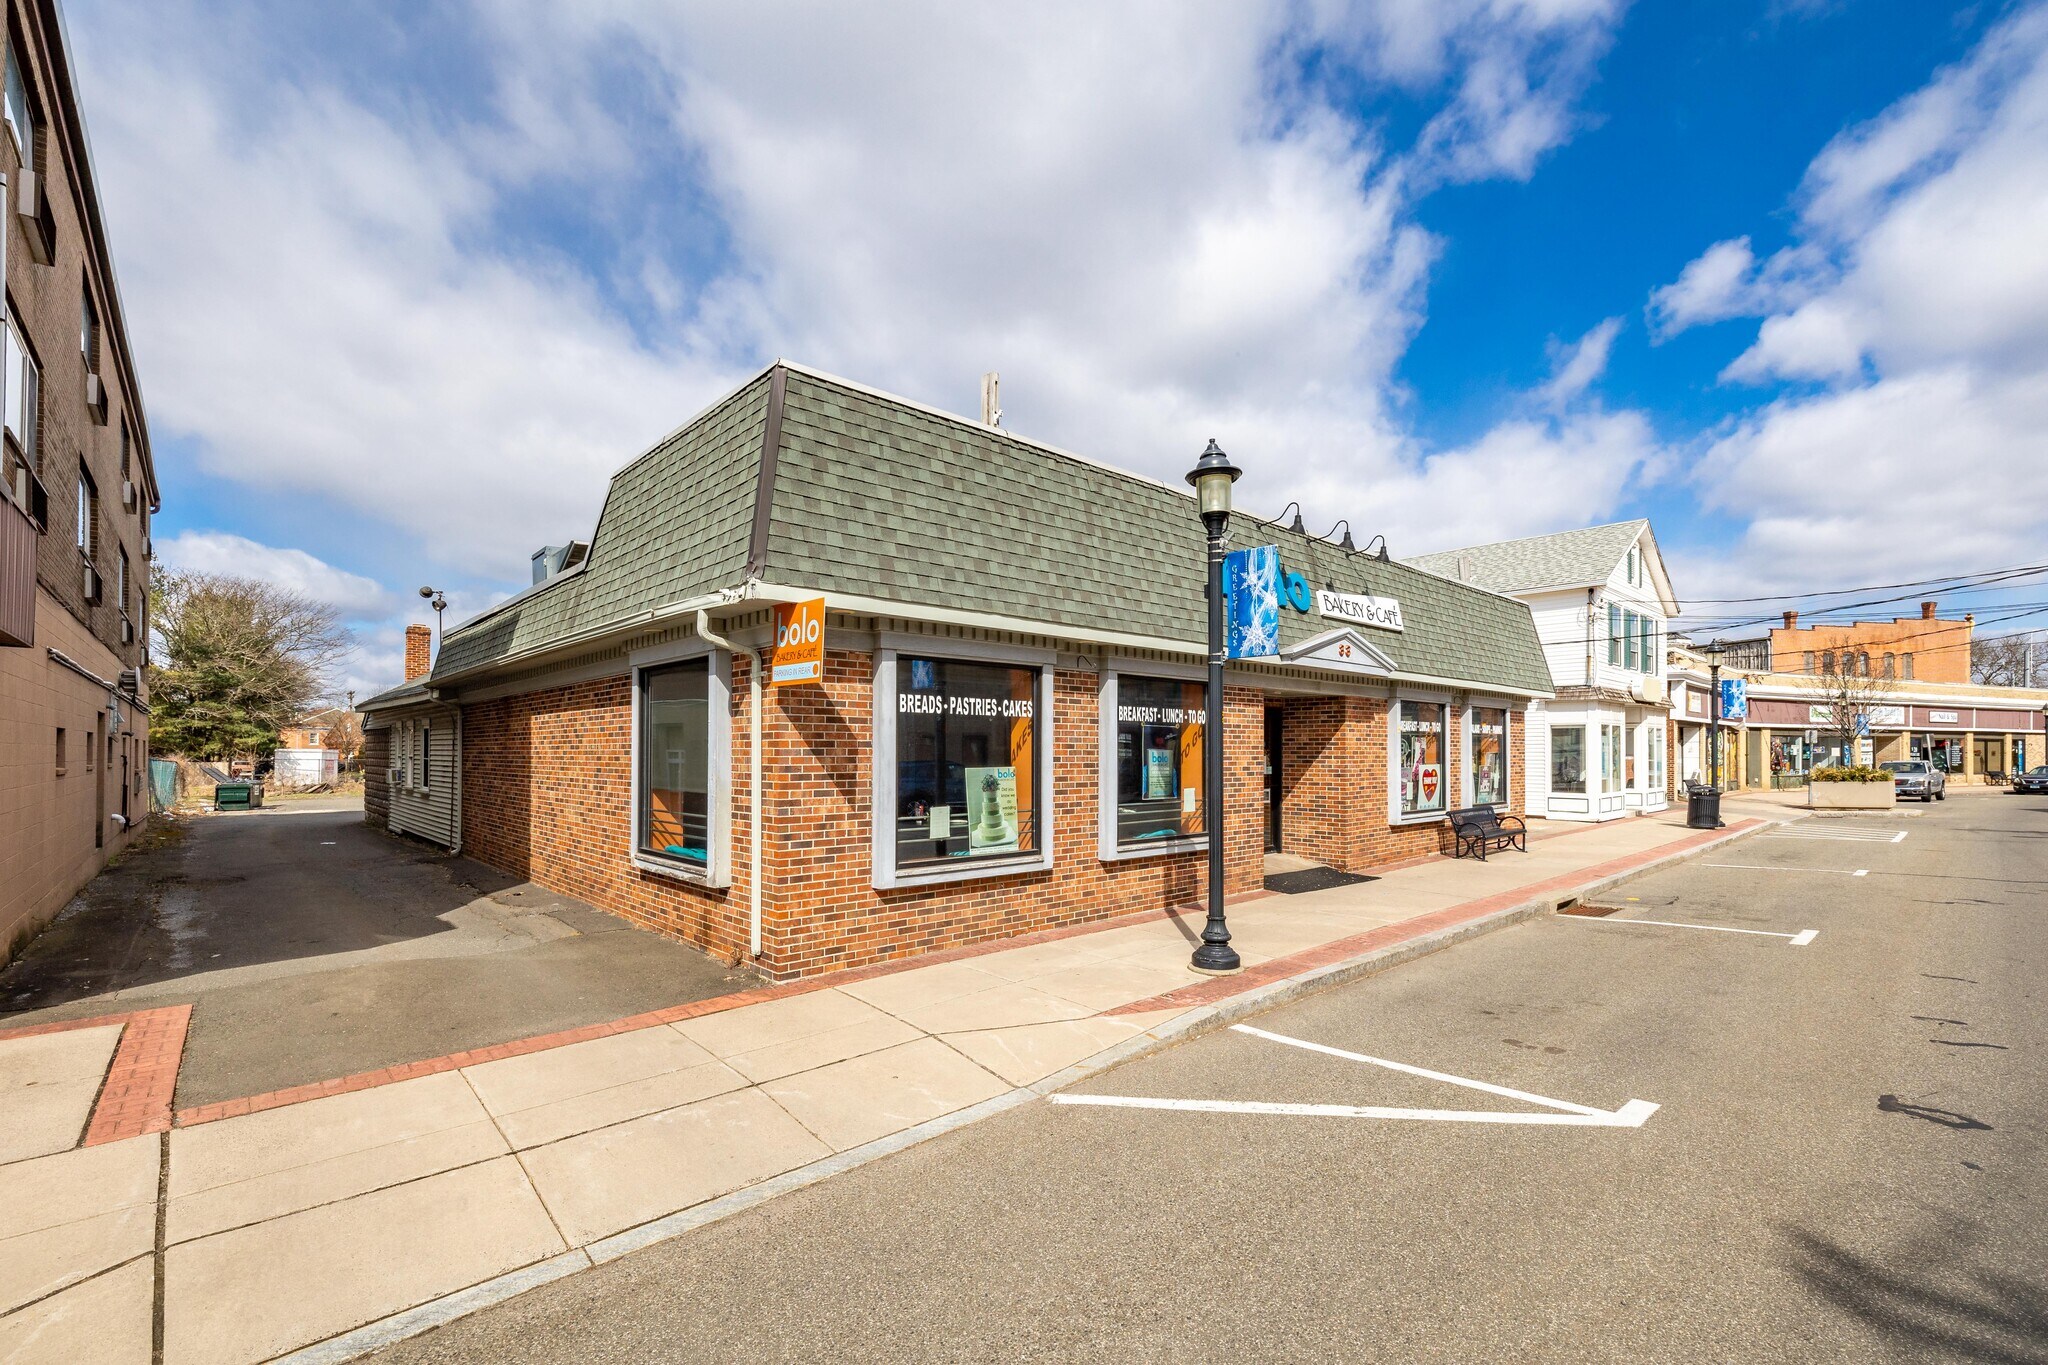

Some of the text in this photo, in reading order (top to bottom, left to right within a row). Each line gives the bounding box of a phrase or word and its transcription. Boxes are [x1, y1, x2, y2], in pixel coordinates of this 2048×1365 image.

[1231, 564, 1240, 647] GREETINGS
[1323, 594, 1402, 627] BAKERY & CAFÉ
[777, 606, 820, 648] bolo
[776, 650, 797, 663] BAKERY
[797, 649, 803, 660] &
[773, 667, 793, 678] PARKING
[798, 665, 812, 676] REAR
[899, 693, 1033, 718] BREADS PASTRIES CAKES
[1118, 705, 1206, 725] BREAKFAST LUNCH TO GO
[1152, 751, 1168, 763] bolo
[997, 768, 1015, 779] bolo
